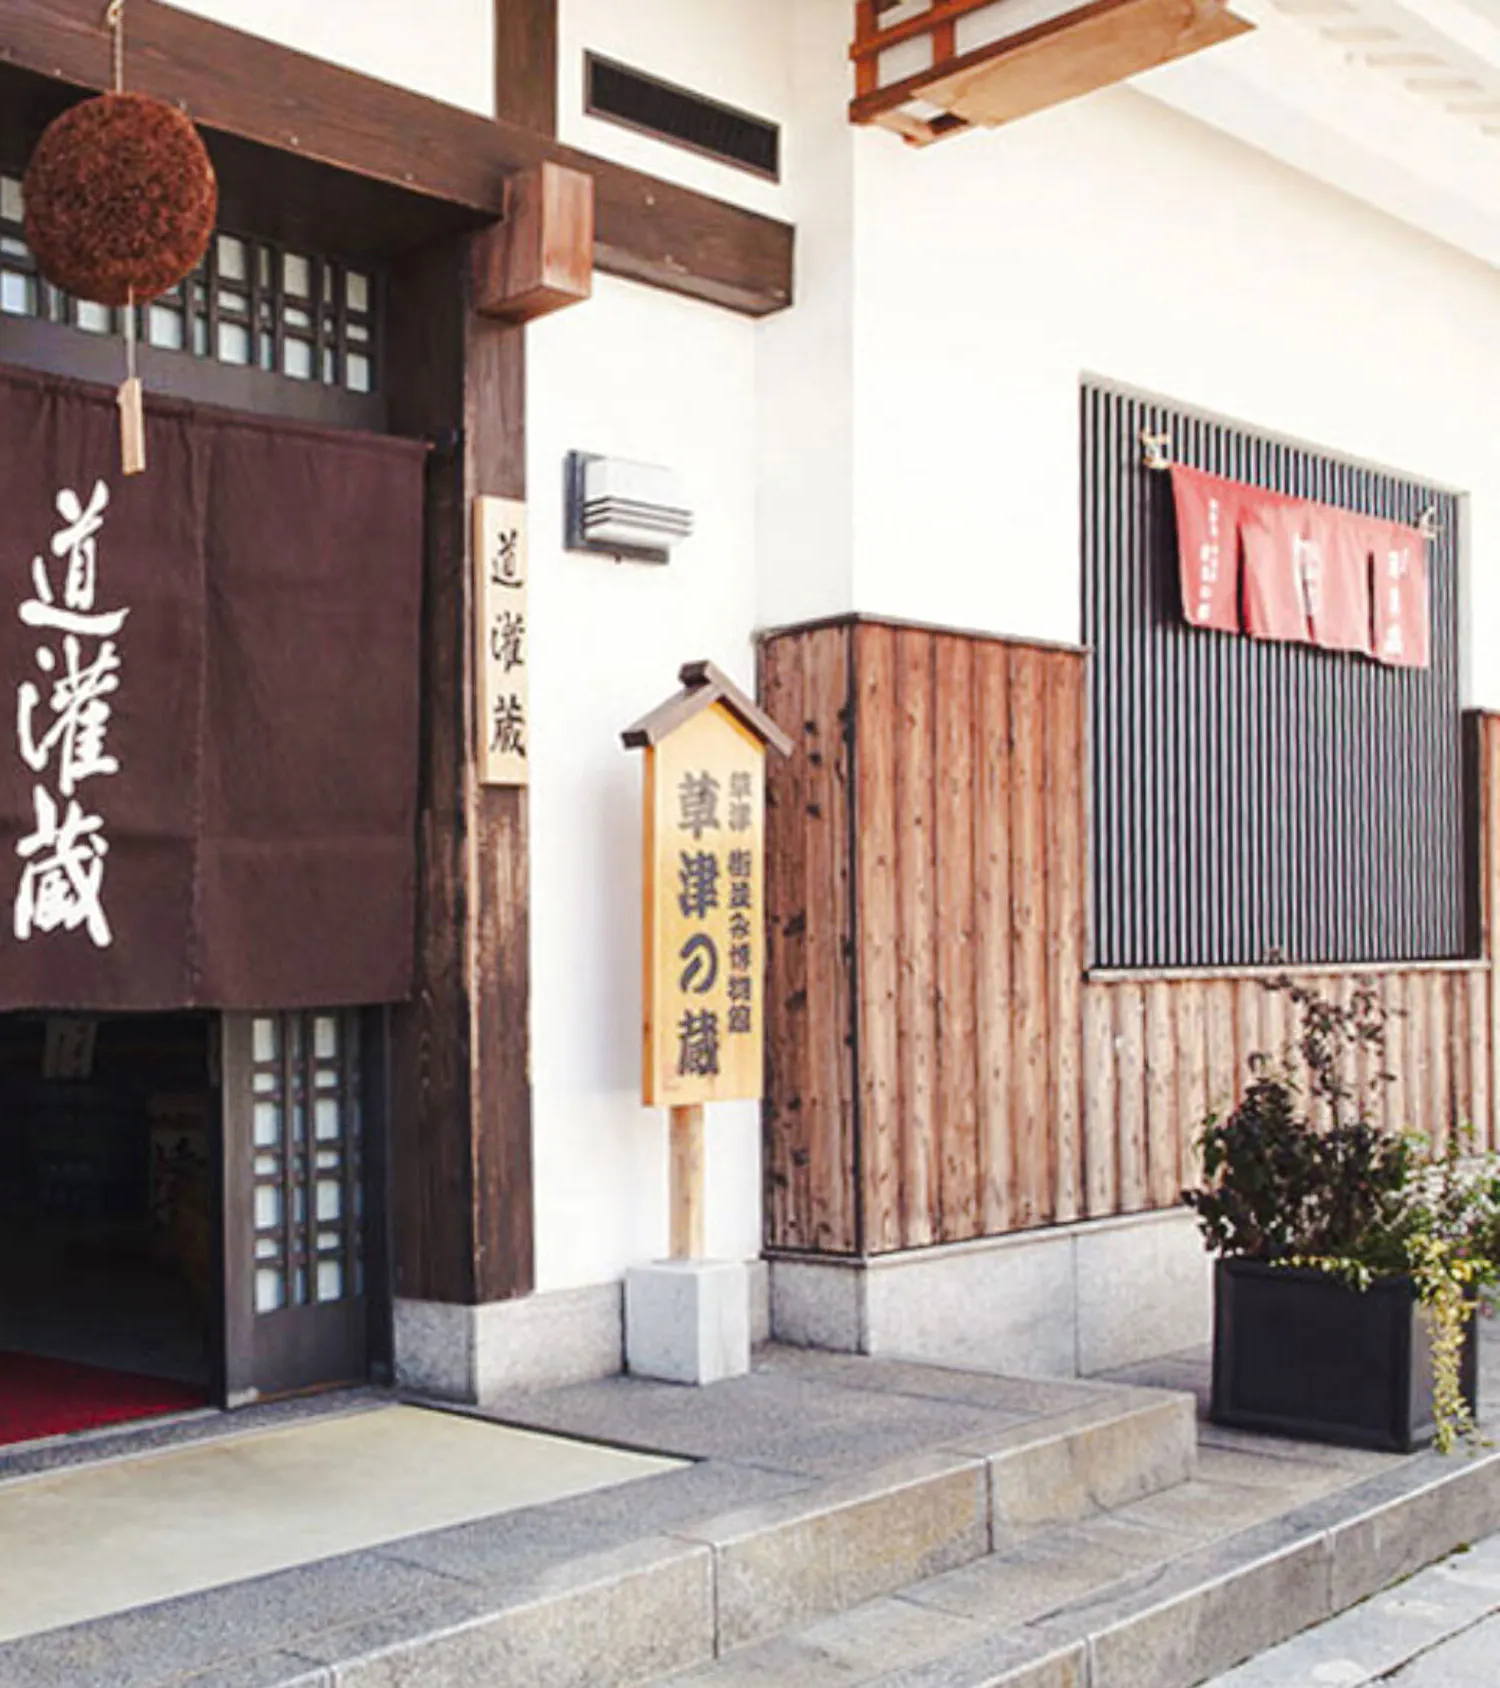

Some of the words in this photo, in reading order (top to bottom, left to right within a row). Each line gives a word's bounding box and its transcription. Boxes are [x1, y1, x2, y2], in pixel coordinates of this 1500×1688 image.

[13, 479, 130, 948] 道灌蔵
[490, 528, 526, 758] 道灌蔵
[677, 770, 721, 1077] 草津の蔵
